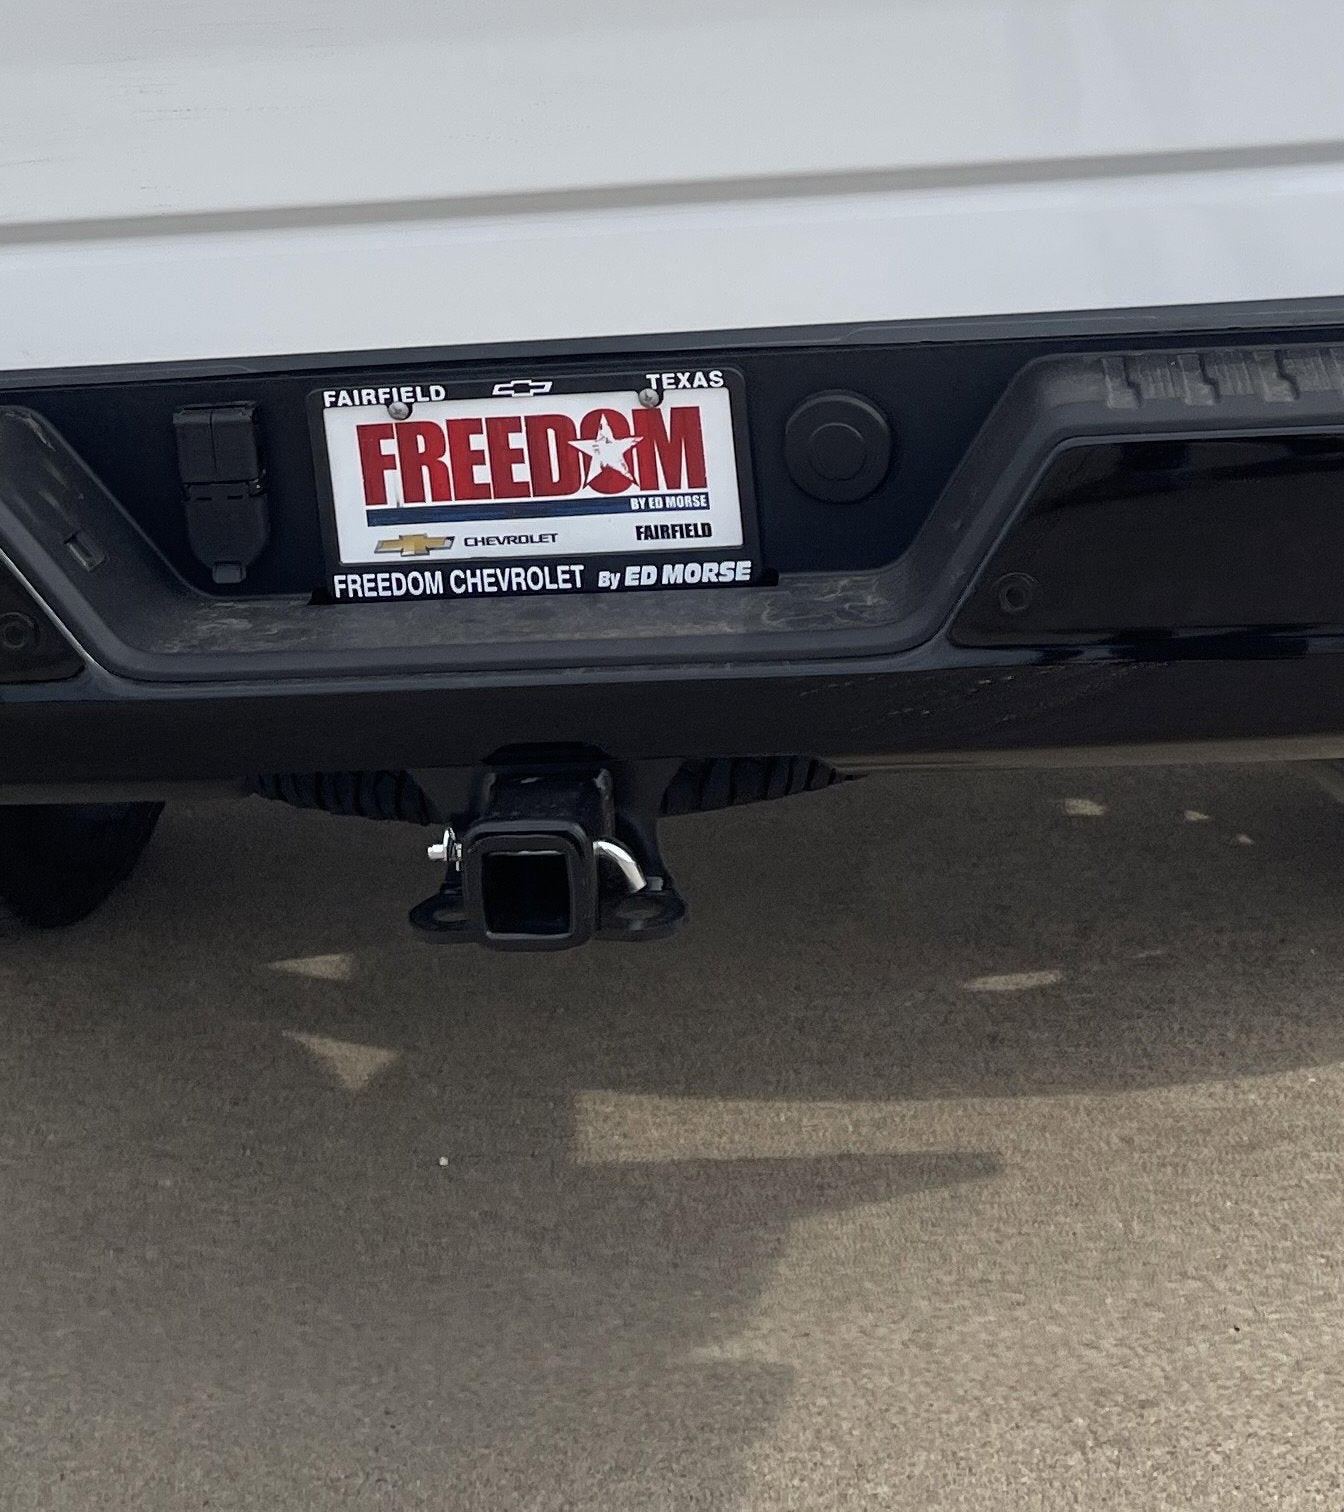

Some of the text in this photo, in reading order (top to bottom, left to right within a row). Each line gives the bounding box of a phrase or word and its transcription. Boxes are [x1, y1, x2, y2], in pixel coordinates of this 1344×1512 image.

[646, 370, 724, 390] TEXAS
[323, 385, 446, 407] FAIRFIELD
[356, 406, 707, 506] FREEDOM
[630, 493, 707, 510] BY ED MORSE
[463, 532, 559, 547] CHEVROLET
[635, 522, 712, 540] FAIRFIELD
[333, 561, 752, 598] FREEDOM CHEVROLET By ED MORSE
